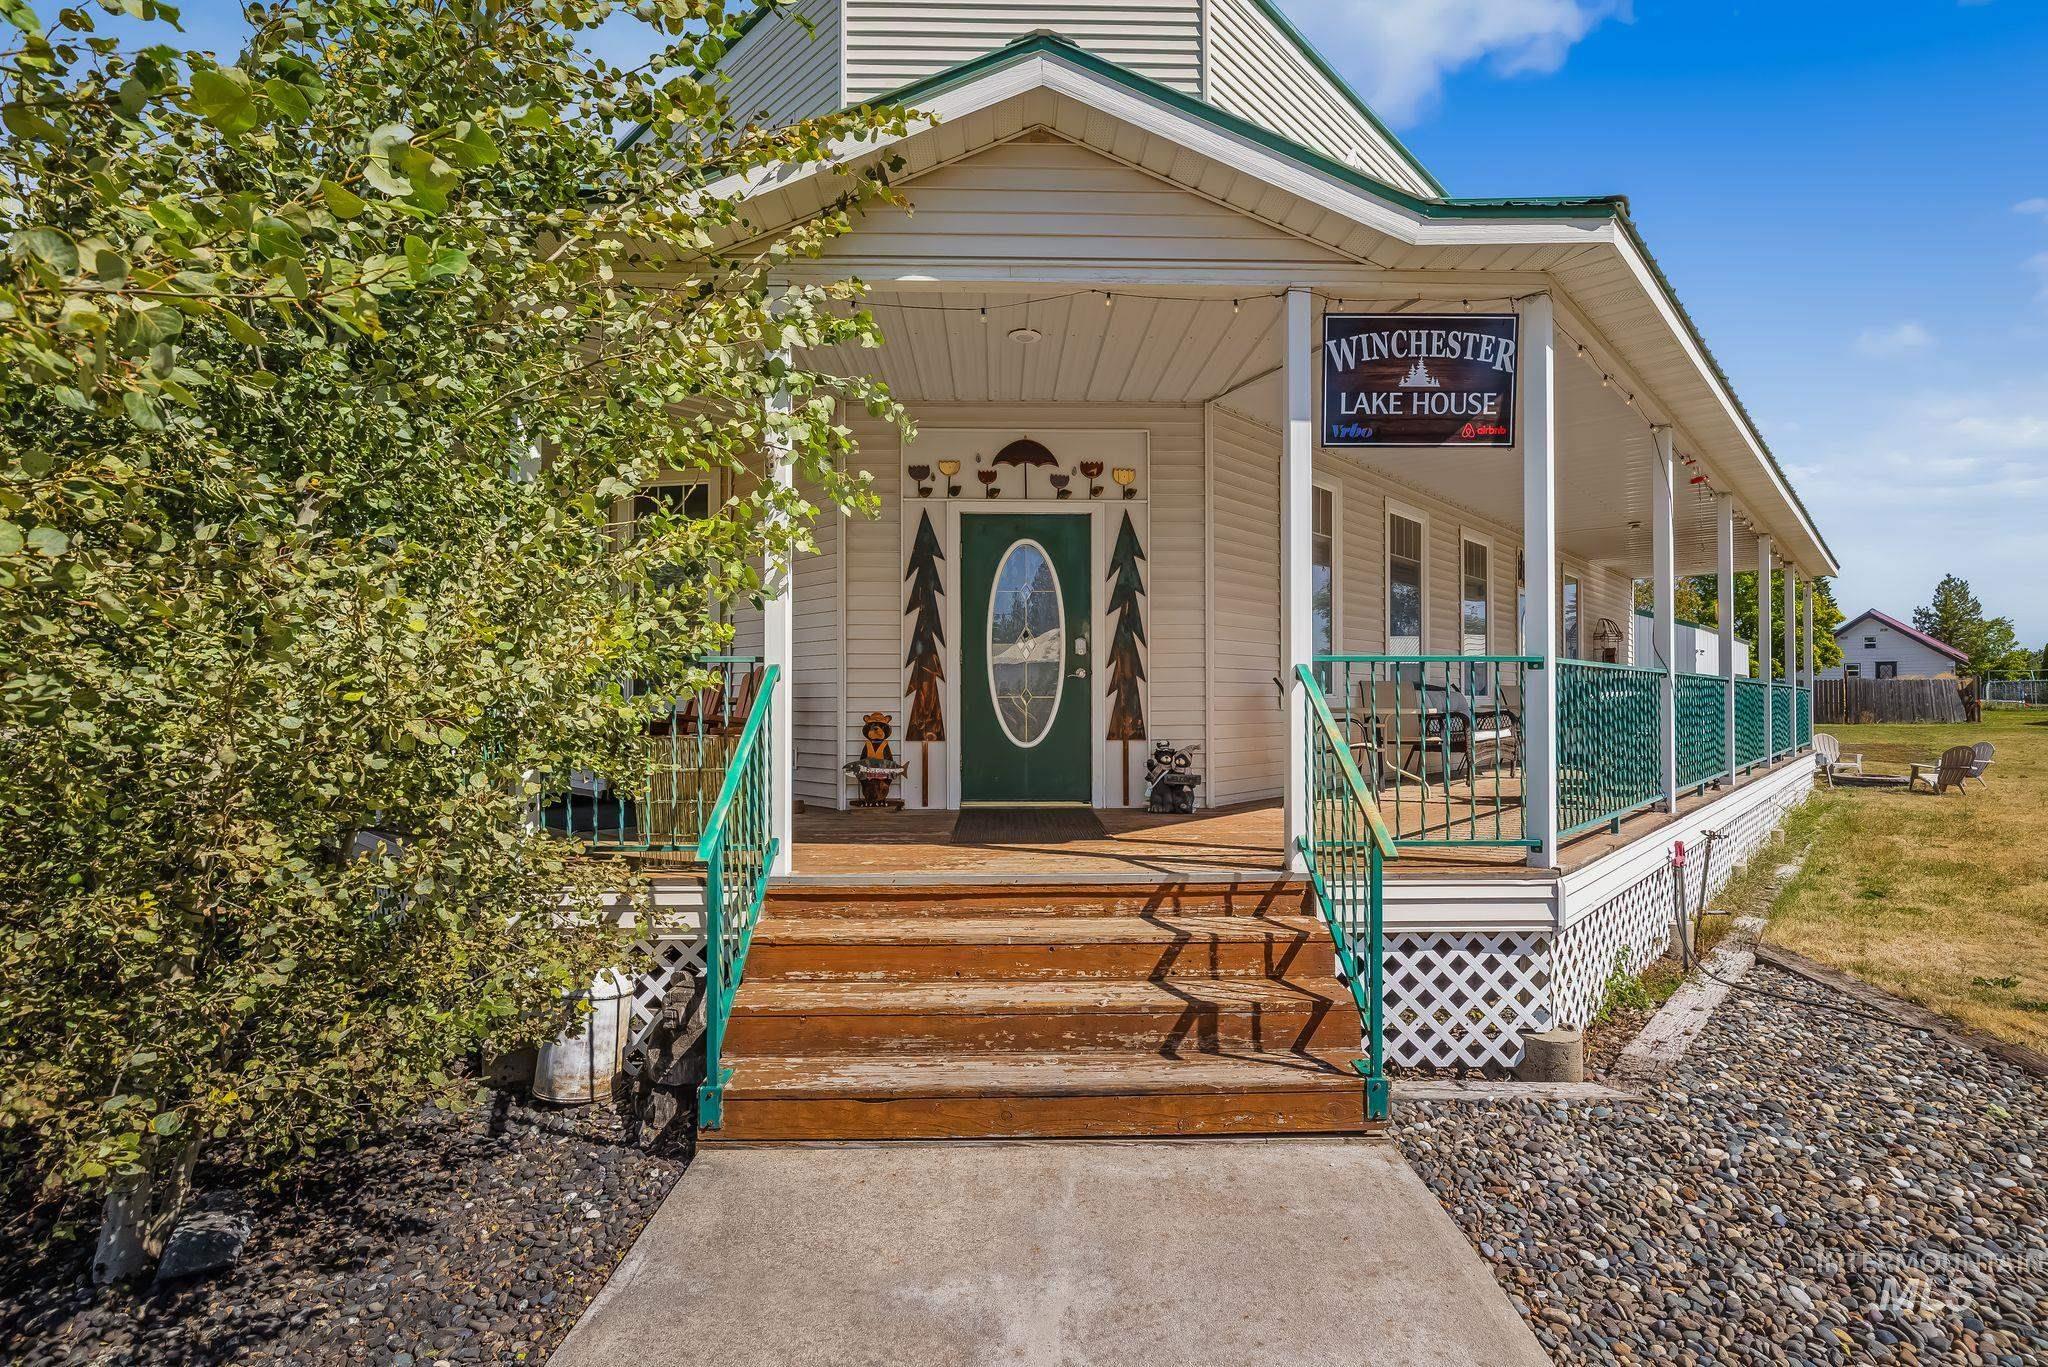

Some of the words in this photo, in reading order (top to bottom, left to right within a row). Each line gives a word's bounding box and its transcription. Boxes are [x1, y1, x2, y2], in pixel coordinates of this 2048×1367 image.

[1326, 330, 1516, 373] WINCHESTER
[1340, 392, 1403, 415] LAKE
[1412, 392, 1497, 415] HOUSE
[1477, 425, 1506, 435] airbnb
